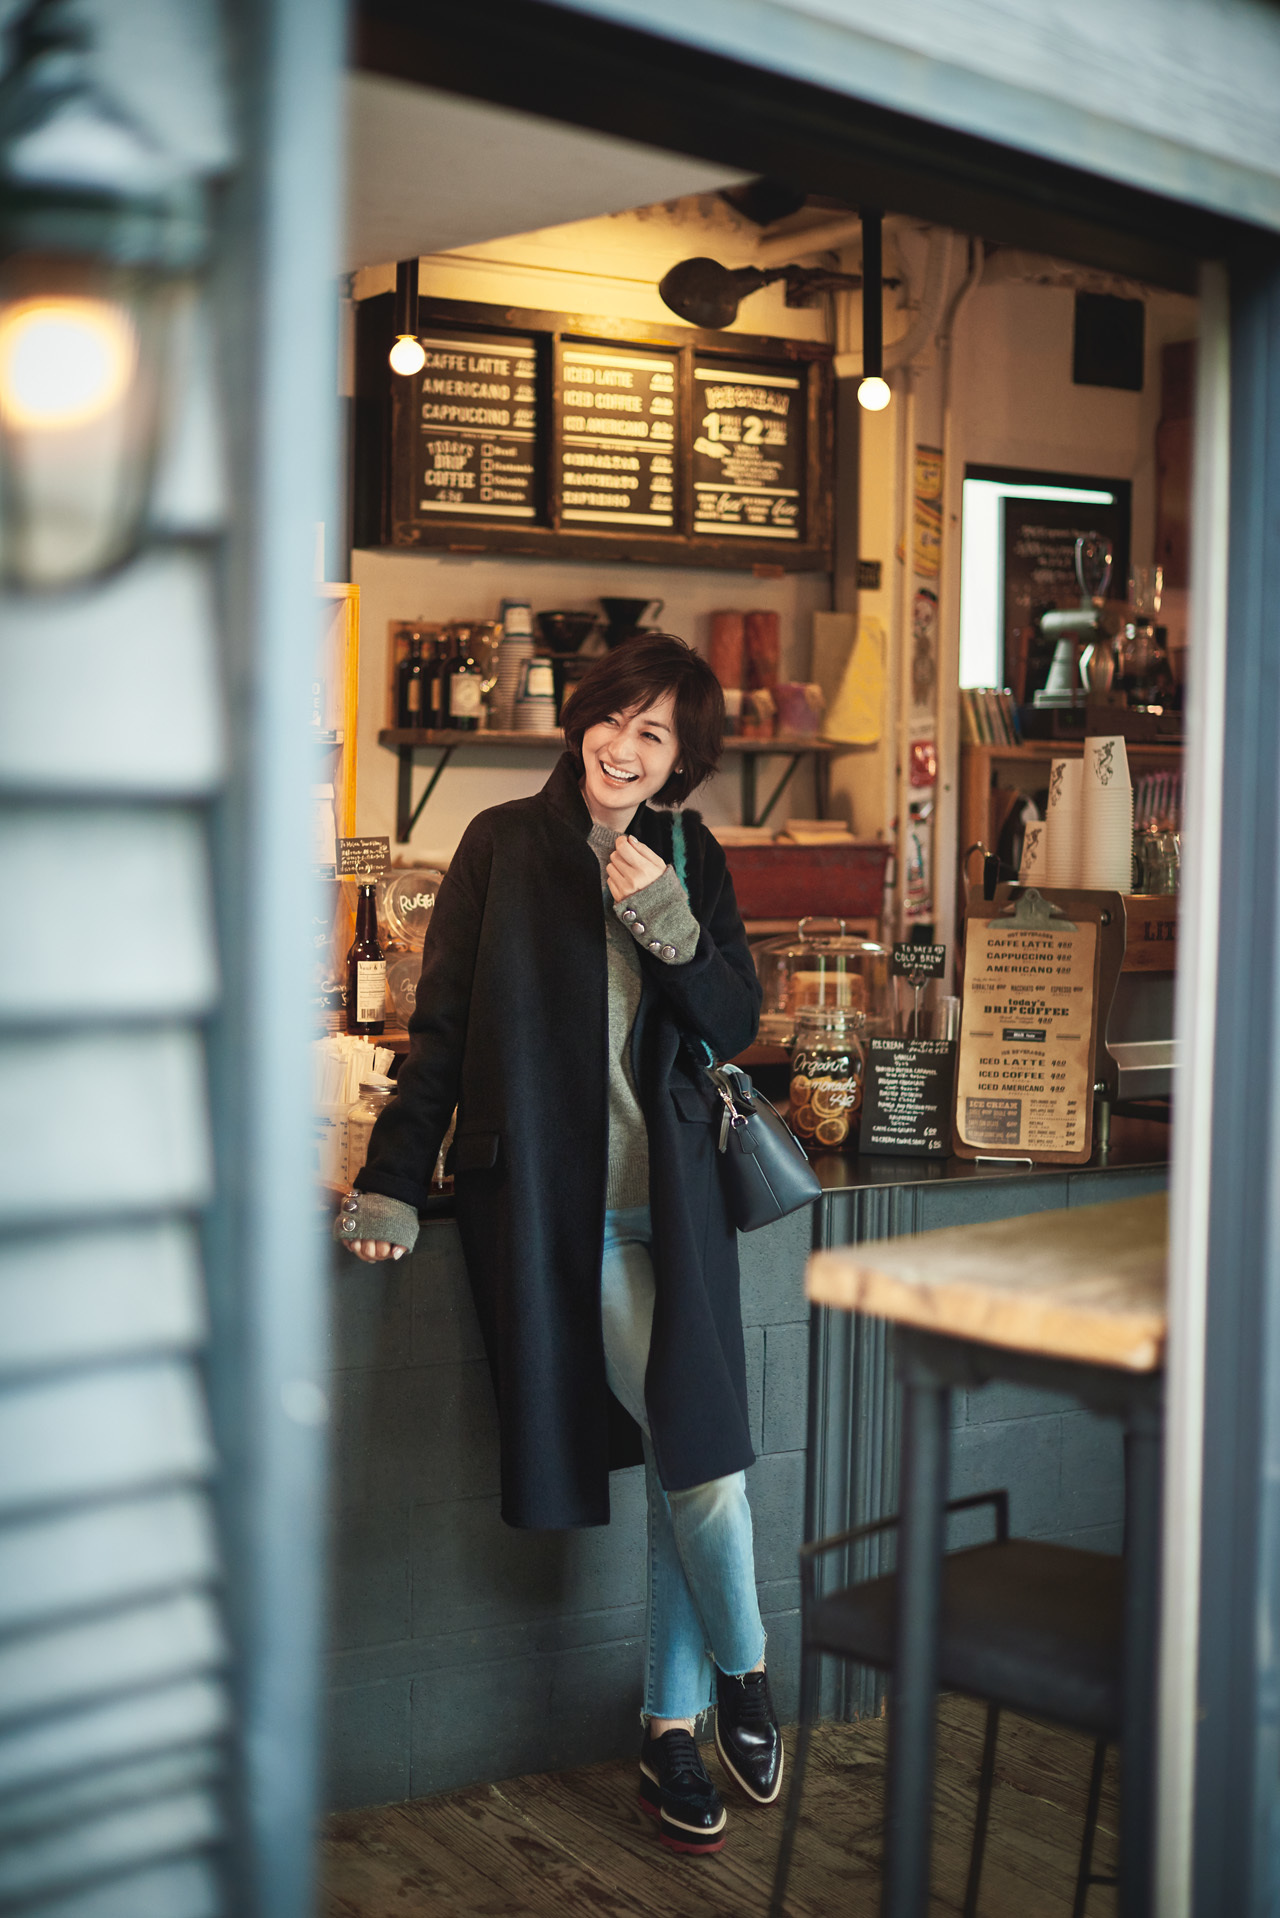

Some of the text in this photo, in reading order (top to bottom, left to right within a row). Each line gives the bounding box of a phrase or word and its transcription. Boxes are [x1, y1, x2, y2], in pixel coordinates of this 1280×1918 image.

[468, 357, 510, 376] LATTE
[422, 378, 510, 400] AMERICANO
[422, 403, 510, 426] CAPPUCCINO
[743, 415, 764, 445] 2
[425, 470, 476, 489] COFFEE
[987, 939, 1019, 948] CAFFE
[1022, 940, 1054, 949] LATTE
[895, 951, 942, 963] COLD BREW
[986, 952, 1054, 961] CAPPUCCINO
[986, 965, 1053, 974] AMERICANO
[1008, 998, 1045, 1007] today's
[984, 1005, 1069, 1016] DRIP COFFEE
[794, 1052, 848, 1076] Organic
[1003, 1058, 1046, 1066] LATTE
[1002, 1071, 1045, 1079] COFFEE
[978, 1083, 998, 1091] ICED
[1001, 1084, 1044, 1092] AMERICANO
[986, 1101, 1018, 1109] CREAM
